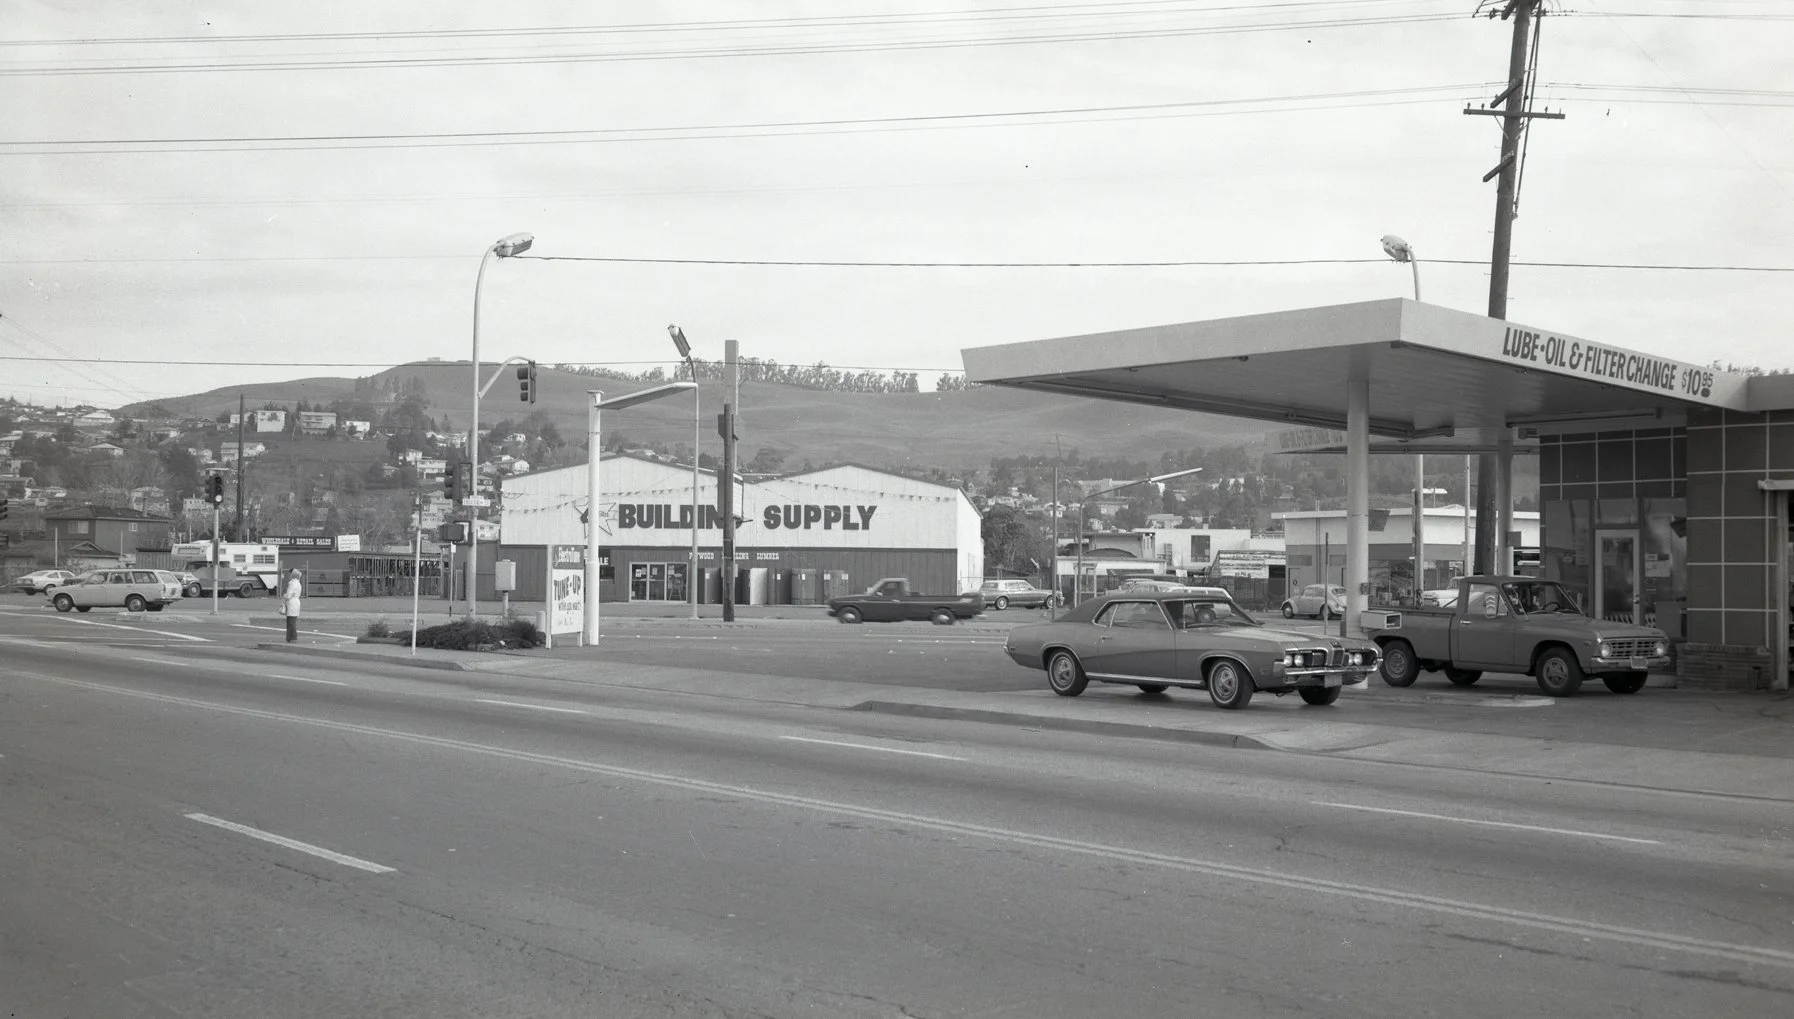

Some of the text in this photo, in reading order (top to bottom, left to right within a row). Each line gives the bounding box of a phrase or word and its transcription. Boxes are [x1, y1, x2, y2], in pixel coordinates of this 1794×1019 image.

[1569, 342, 1584, 370] &
[1626, 354, 1677, 391] CHANGE
[618, 503, 877, 531] BUILDIN SUPPLY
[689, 552, 714, 560] PWOOD
[756, 552, 780, 560] LUMBER
[553, 574, 581, 601] TUNE-UP
